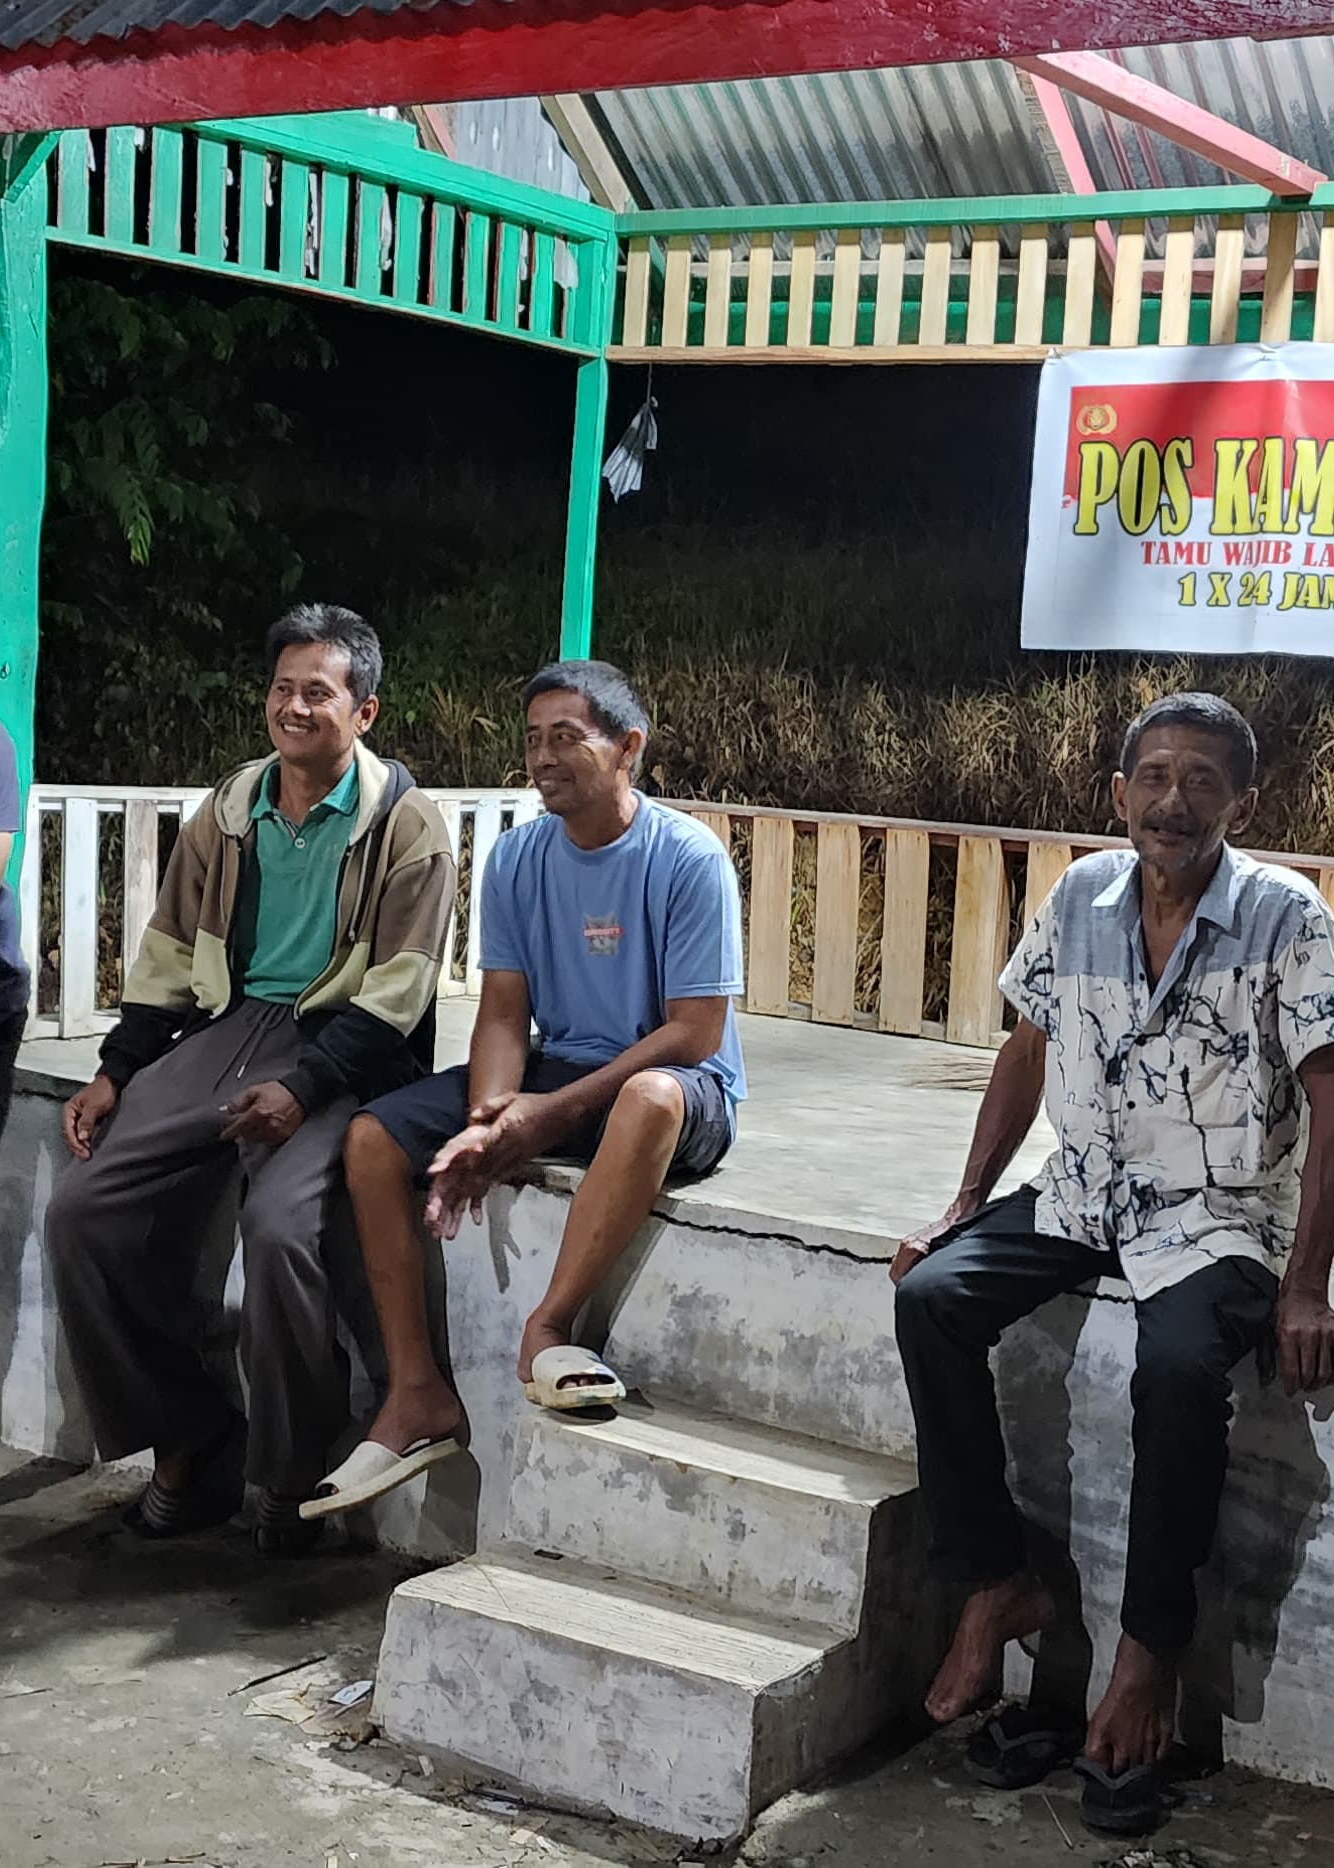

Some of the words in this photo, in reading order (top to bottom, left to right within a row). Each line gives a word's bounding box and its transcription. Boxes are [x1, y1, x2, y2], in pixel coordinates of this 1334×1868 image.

[1073, 436, 1194, 537] POS
[1141, 540, 1212, 566] TAMU
[1223, 539, 1292, 568] WAJIB
[1178, 571, 1196, 606] 1
[1206, 572, 1232, 607] X
[1237, 571, 1272, 607] 24
